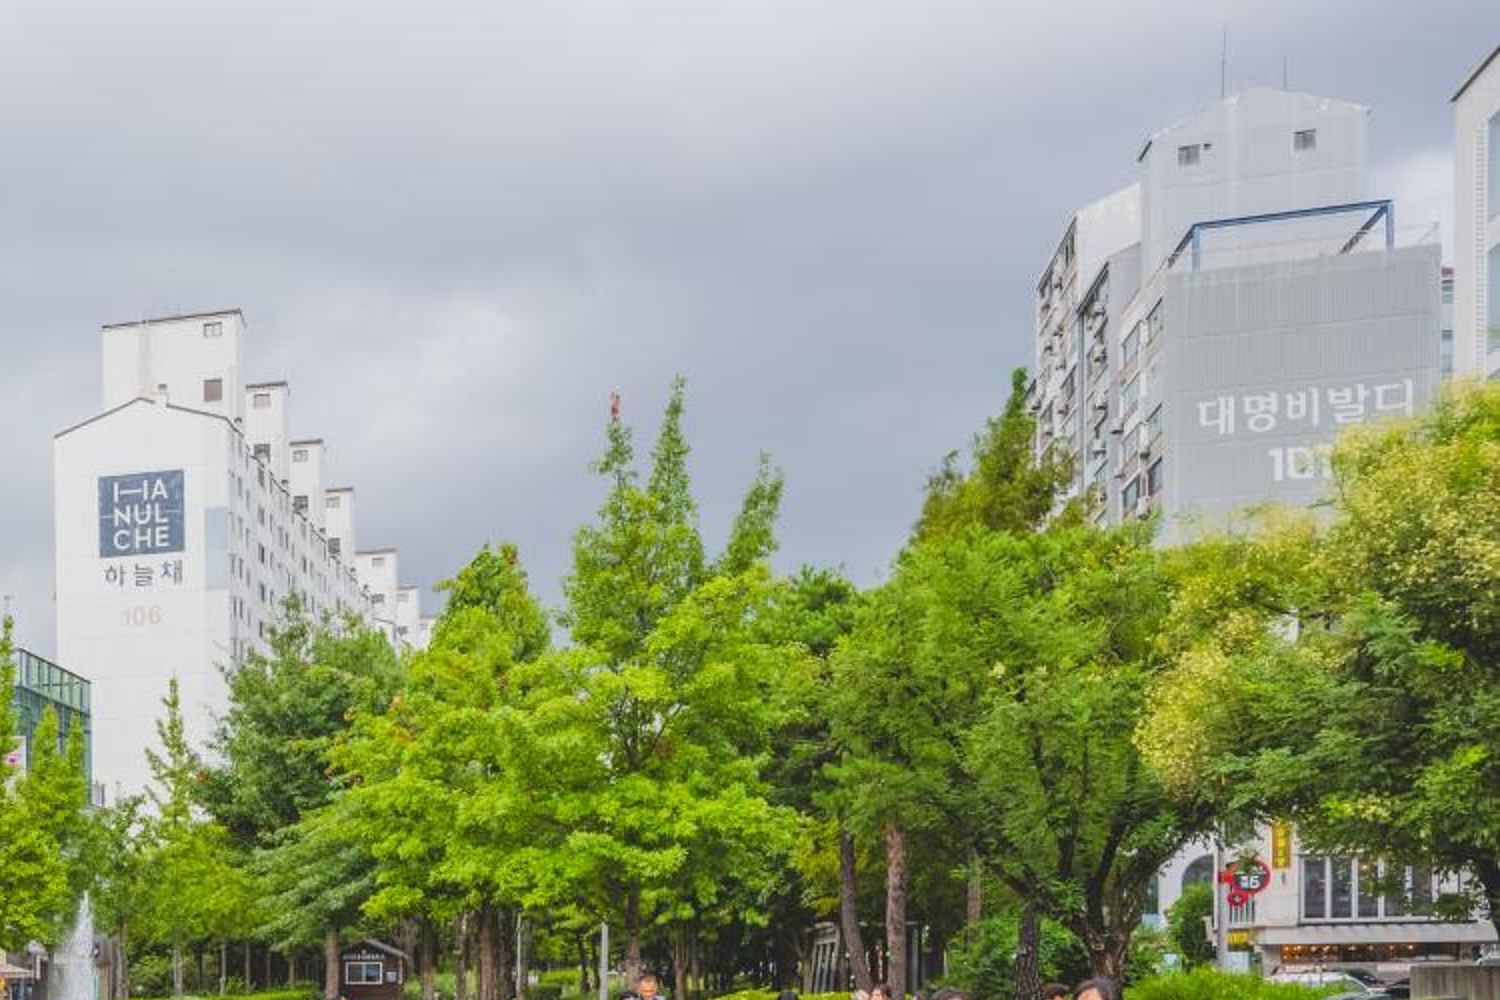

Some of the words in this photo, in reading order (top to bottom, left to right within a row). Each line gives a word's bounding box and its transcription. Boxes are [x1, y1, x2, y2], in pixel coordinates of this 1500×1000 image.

[1197, 379, 1414, 435] 대명비발디
[113, 503, 169, 527] NUL
[113, 526, 170, 550] CHE
[104, 560, 183, 587] 하늘채
[120, 605, 163, 627] 106
